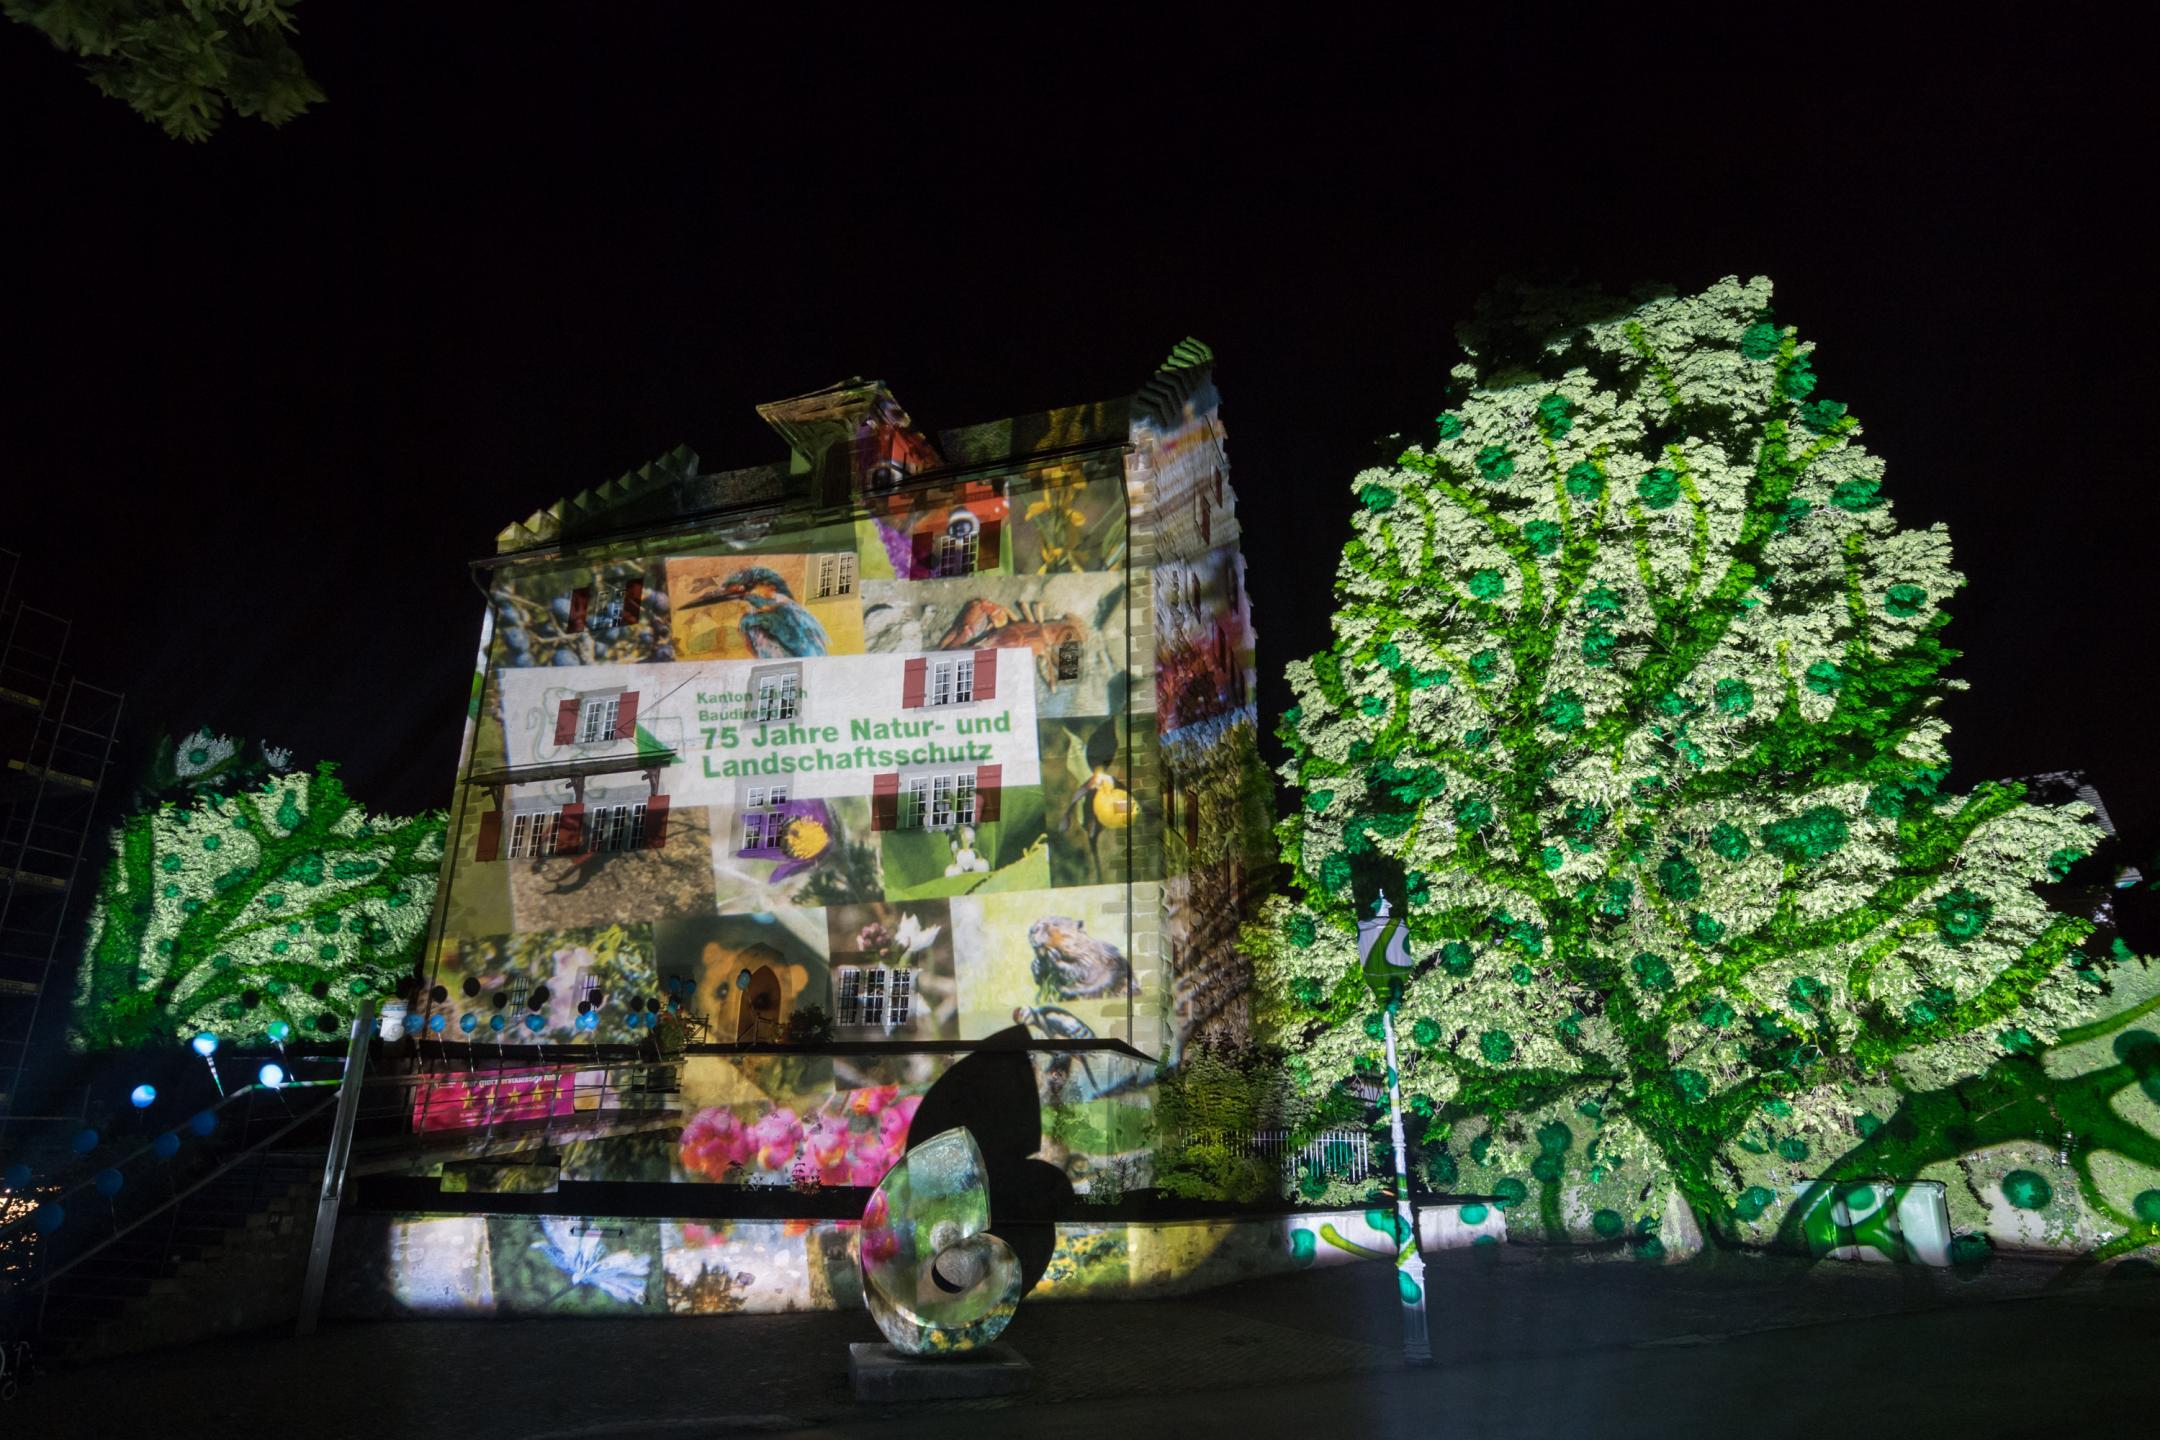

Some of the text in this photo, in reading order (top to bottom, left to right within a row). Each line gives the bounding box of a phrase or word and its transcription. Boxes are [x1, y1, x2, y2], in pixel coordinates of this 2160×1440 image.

[696, 691, 753, 704] Kanton
[700, 711, 1011, 750] 75 Jahre Natur- und
[702, 740, 993, 779] Landschaftsschutz
